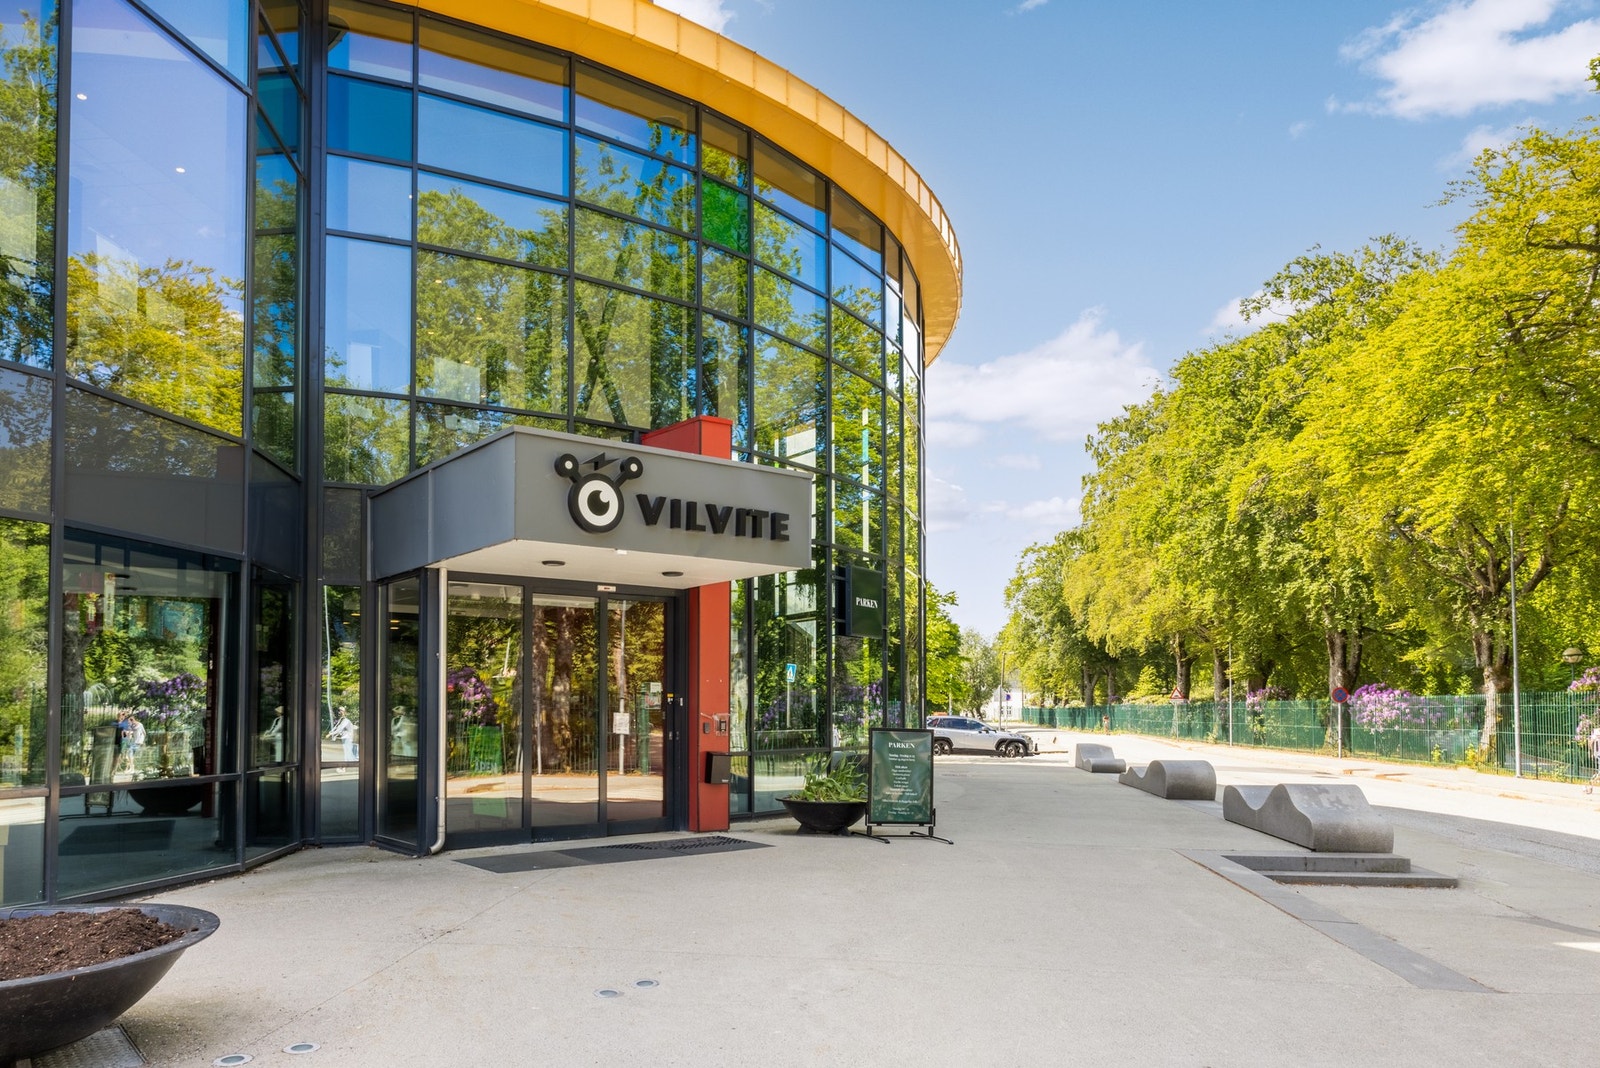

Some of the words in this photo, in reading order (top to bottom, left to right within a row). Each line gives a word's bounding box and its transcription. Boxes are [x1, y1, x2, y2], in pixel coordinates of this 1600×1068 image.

[636, 493, 790, 542] VILVITE
[855, 596, 878, 609] PARKEN
[888, 741, 915, 749] PARKEN
